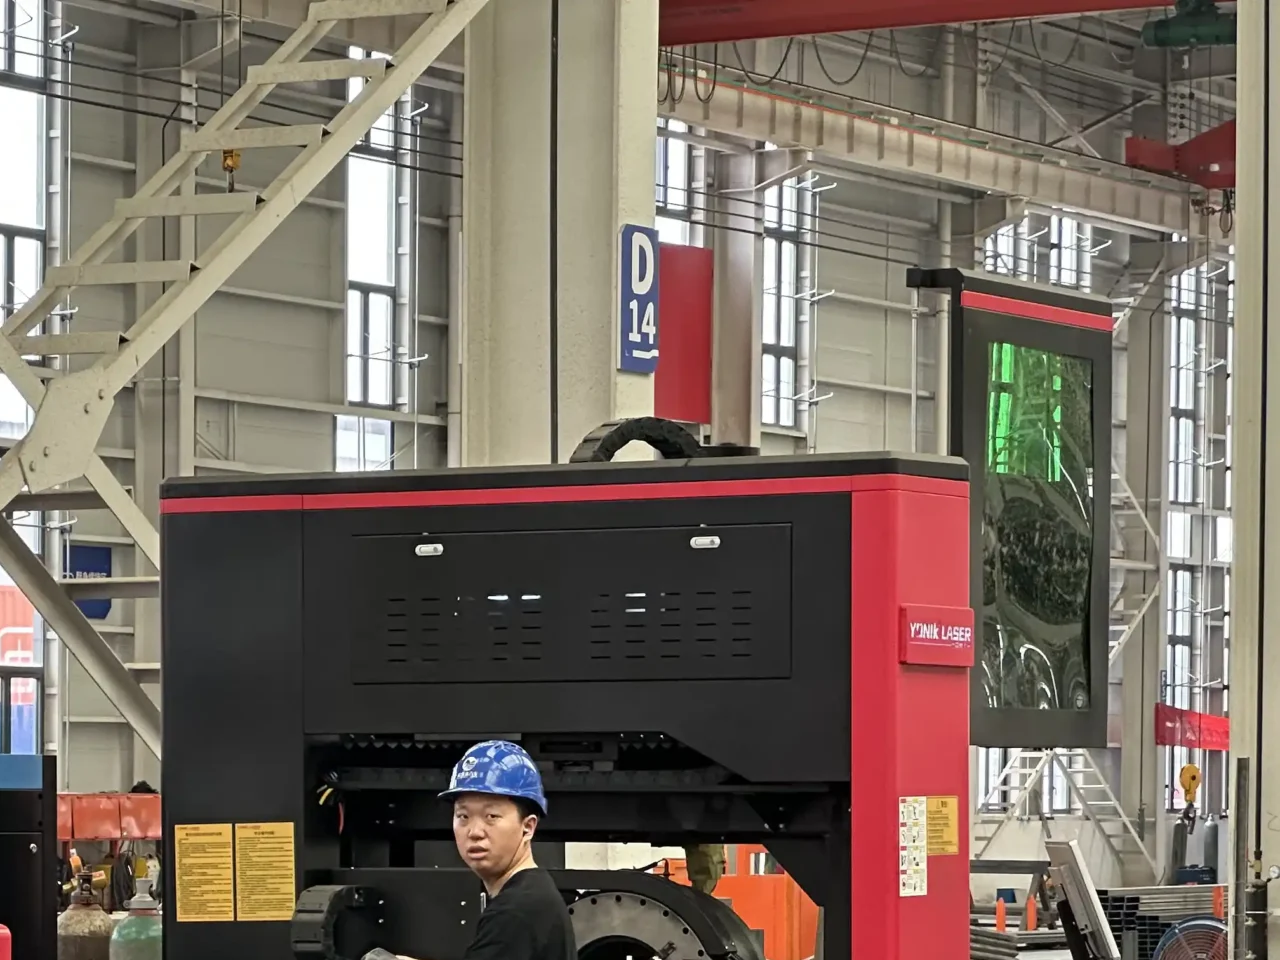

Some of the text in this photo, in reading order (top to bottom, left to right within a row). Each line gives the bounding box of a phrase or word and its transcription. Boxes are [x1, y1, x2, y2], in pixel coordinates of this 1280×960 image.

[632, 231, 654, 295] D
[628, 299, 656, 345] 14
[941, 625, 972, 642] LASER
